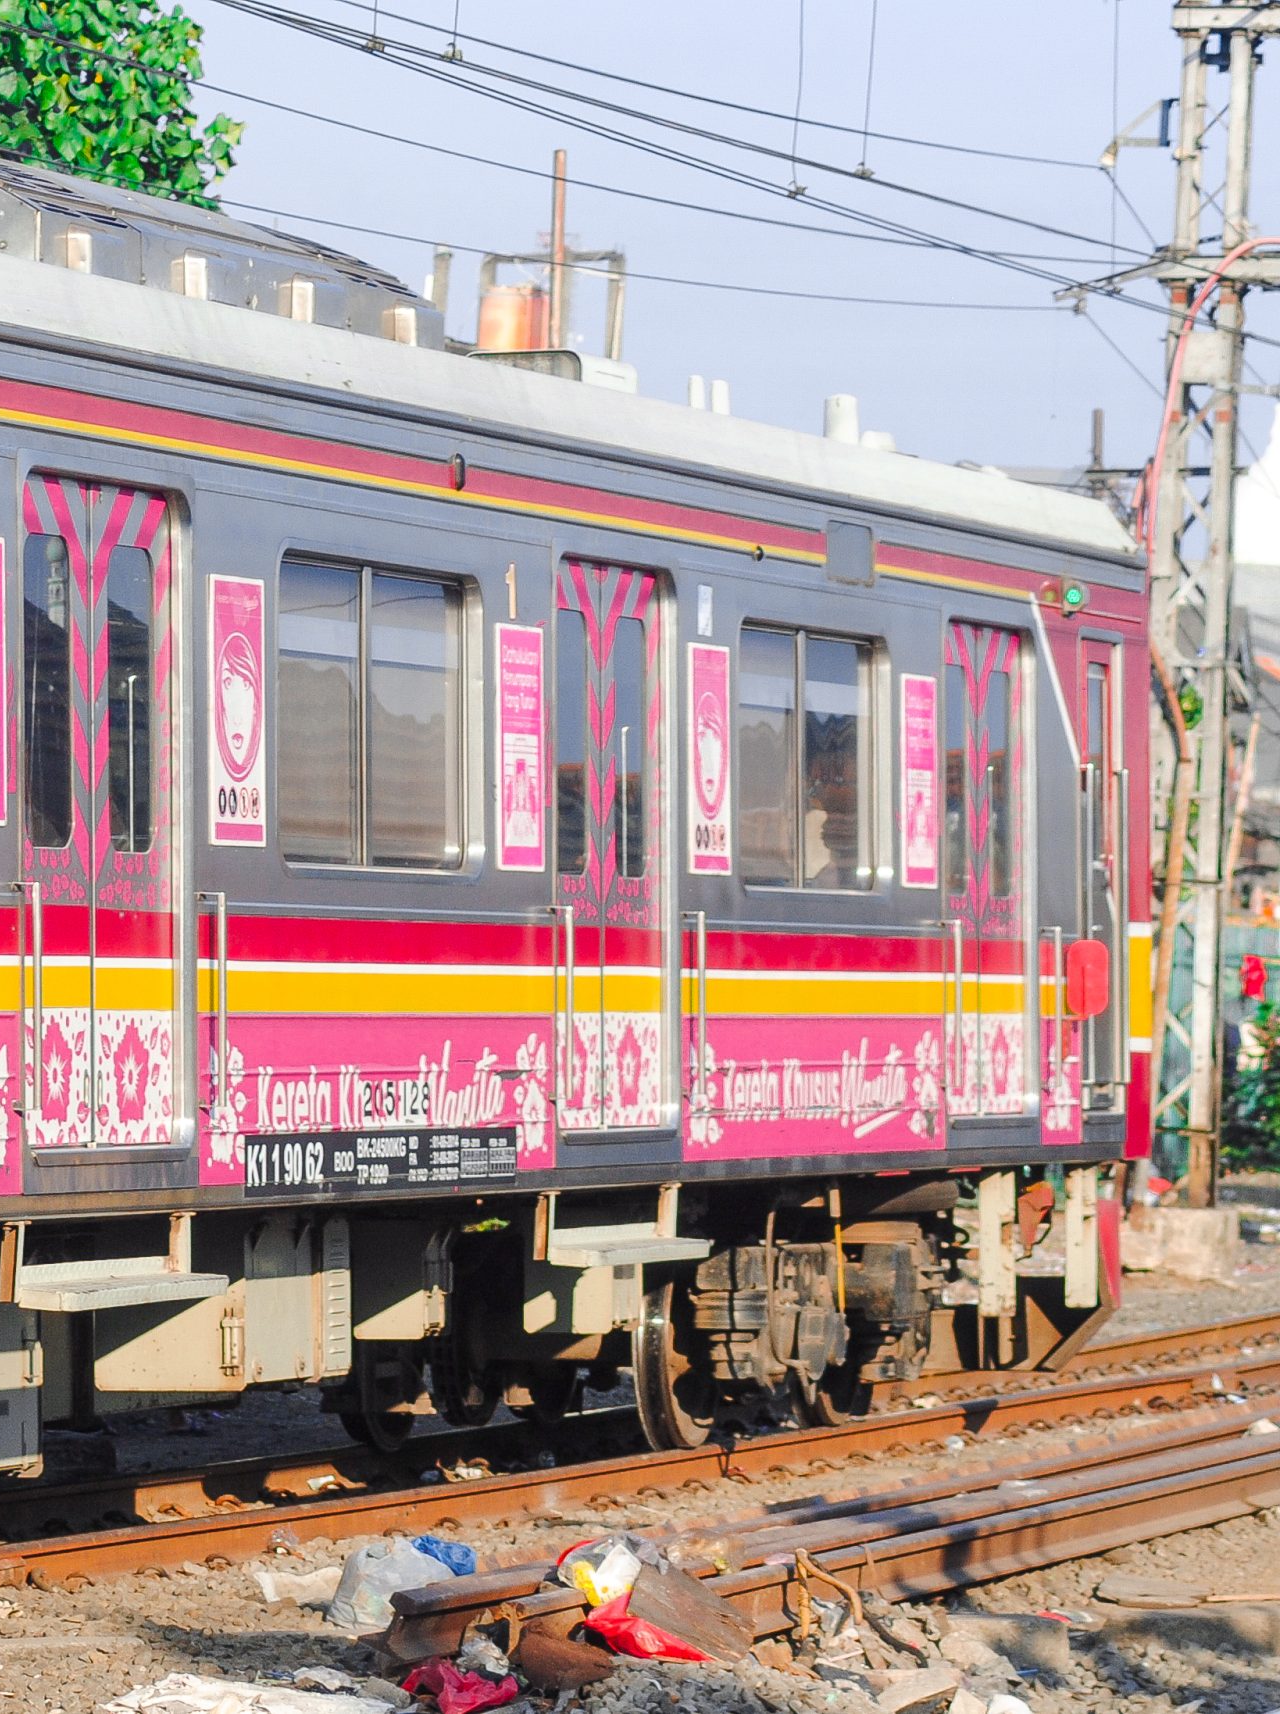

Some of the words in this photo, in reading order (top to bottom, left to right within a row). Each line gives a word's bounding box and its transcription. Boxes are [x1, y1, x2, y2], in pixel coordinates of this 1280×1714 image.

[505, 563, 517, 620] 1
[256, 1065, 333, 1133] Kereta
[723, 1059, 780, 1122] Kereta
[782, 1058, 840, 1120] Khusus
[840, 1037, 908, 1128] Wanita
